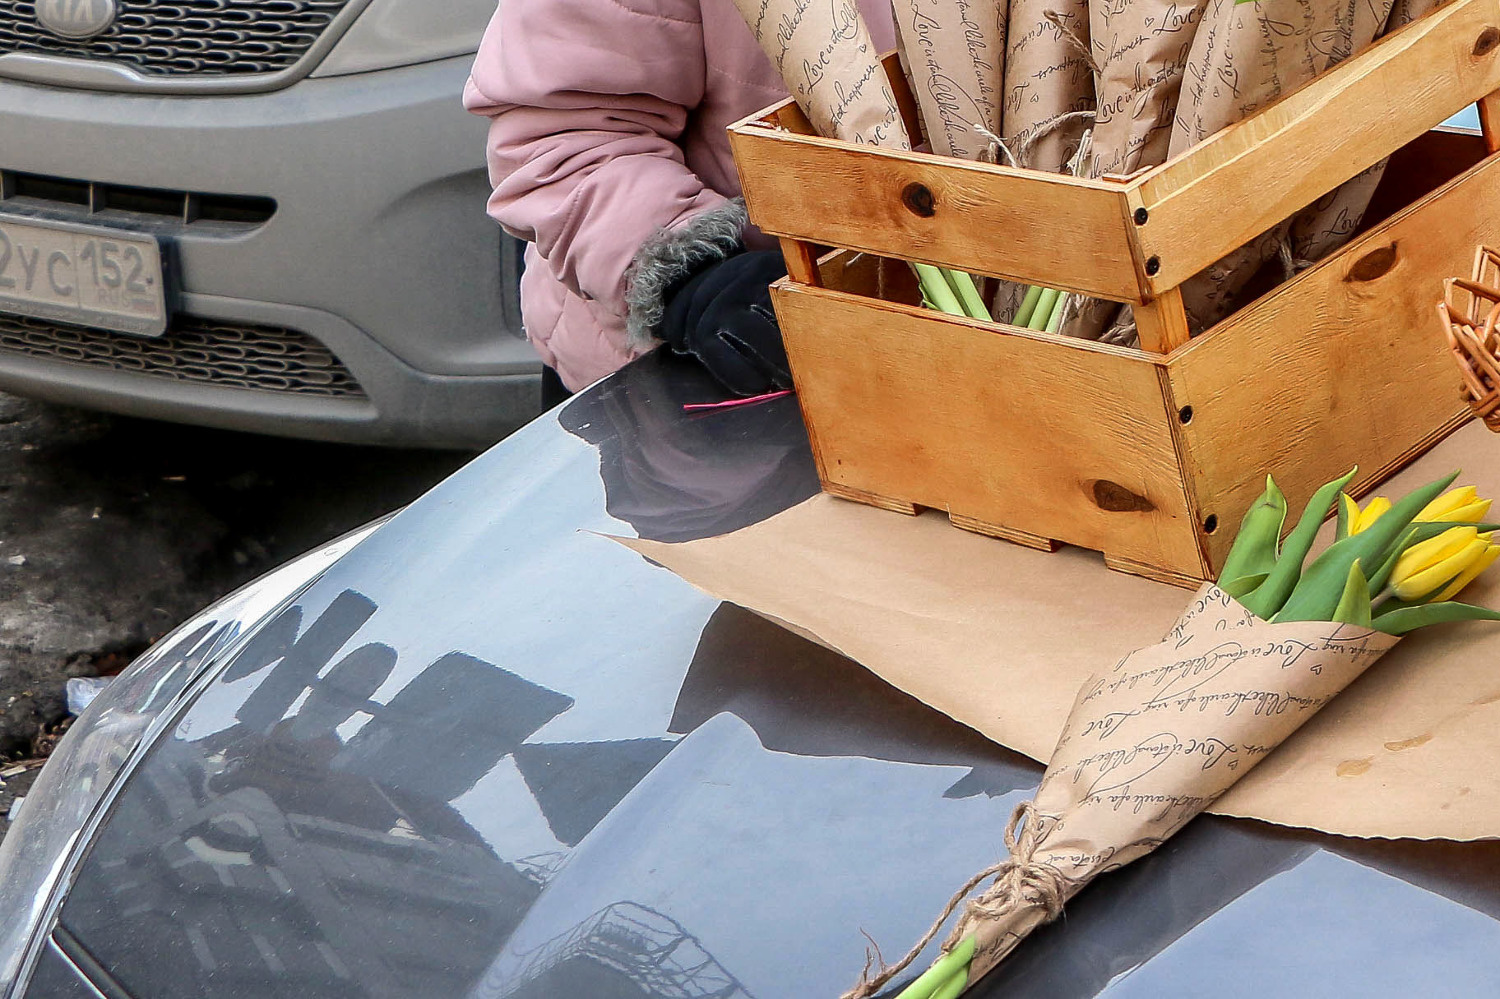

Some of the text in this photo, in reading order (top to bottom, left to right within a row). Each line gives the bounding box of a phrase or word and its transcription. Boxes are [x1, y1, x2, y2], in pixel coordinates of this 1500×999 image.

[911, 4, 941, 46] Love
[1152, 2, 1196, 36] Love
[804, 51, 830, 94] Love
[827, 44, 835, 54] is
[925, 48, 932, 57] is
[834, 65, 879, 106] happiness
[1217, 49, 1241, 99] Love
[1094, 91, 1124, 124] Love
[80, 240, 146, 293] 152
[1250, 648, 1261, 657] is
[1263, 639, 1317, 669] Love
[1081, 710, 1141, 741] Love
[1185, 738, 1237, 771] Love
